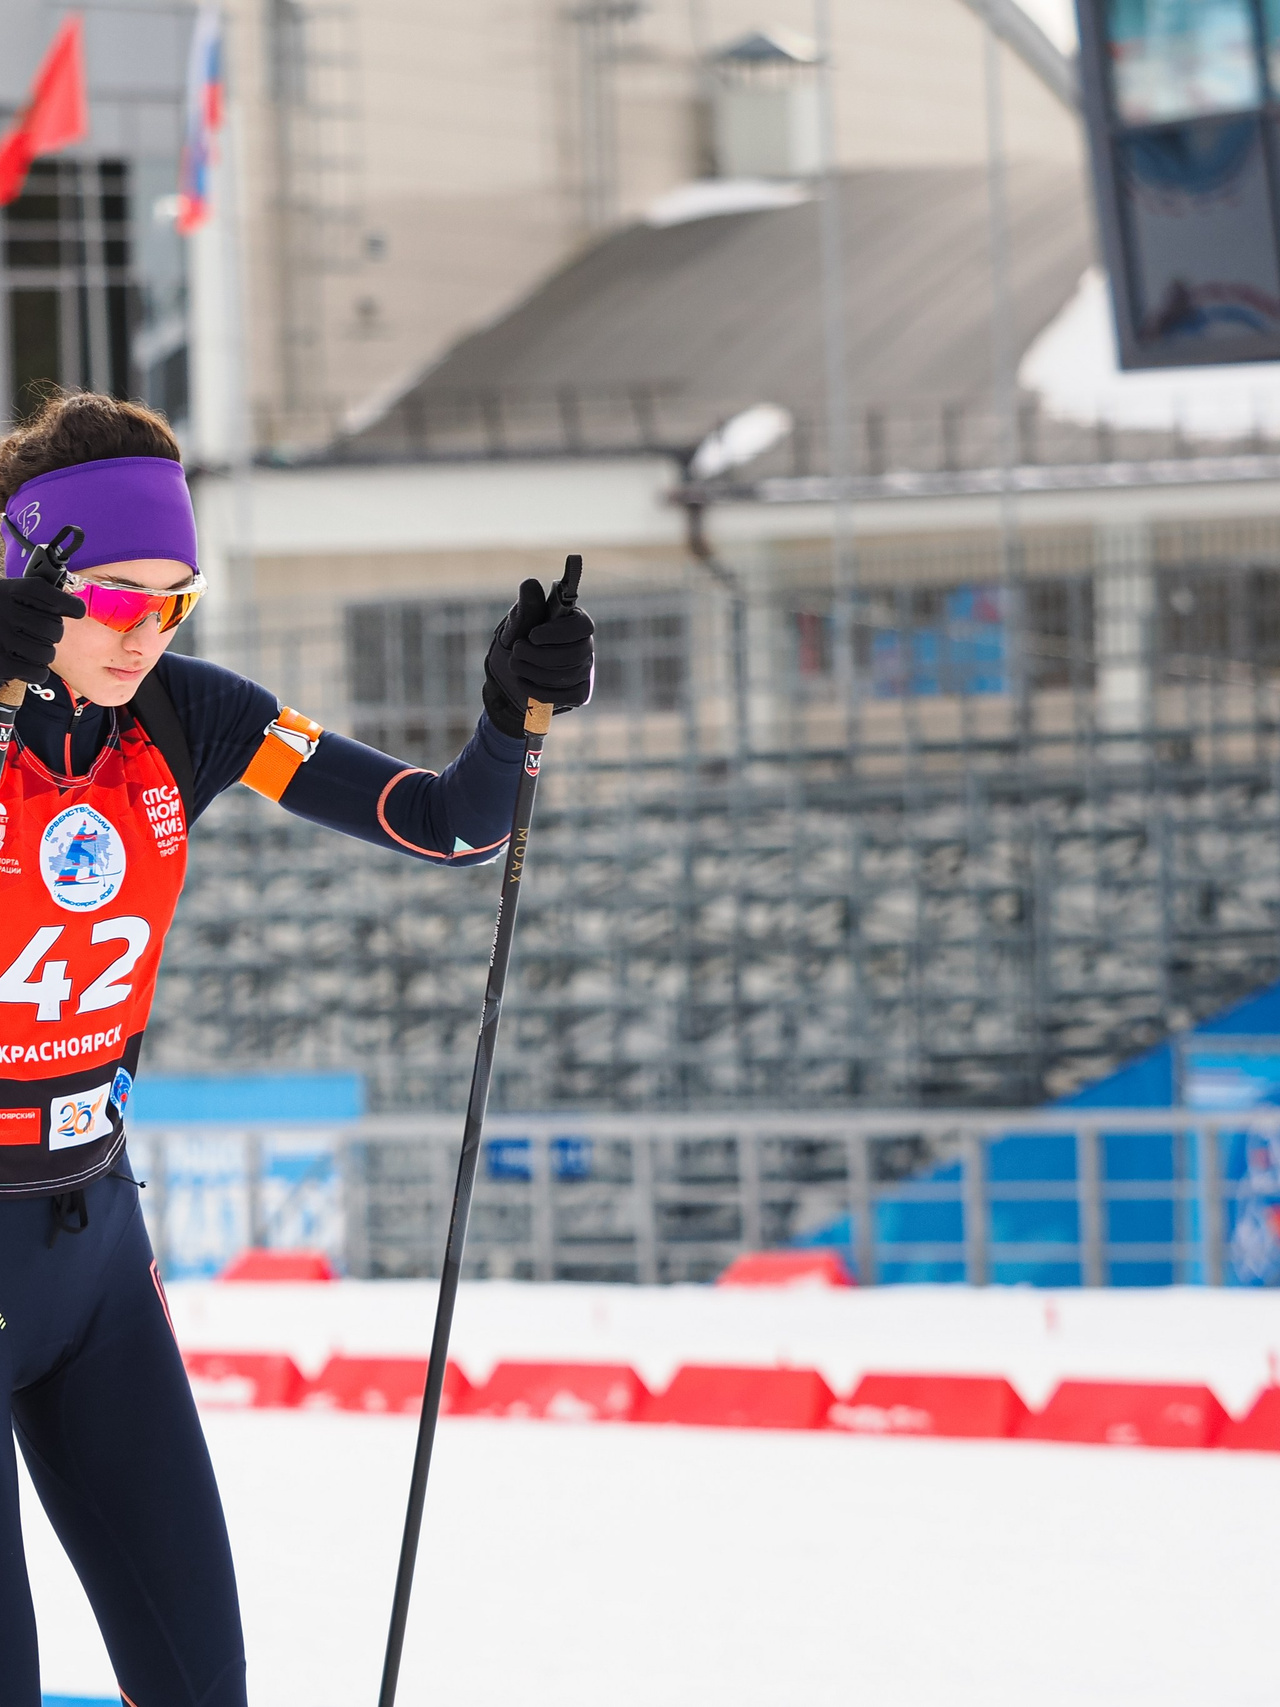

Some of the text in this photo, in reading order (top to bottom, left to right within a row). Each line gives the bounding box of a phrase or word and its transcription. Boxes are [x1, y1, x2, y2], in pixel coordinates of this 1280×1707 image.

[45, 807, 85, 841] ПЕРВЕНСТВ
[151, 817, 184, 839] ЖИЗ
[509, 828, 529, 883] MOAX
